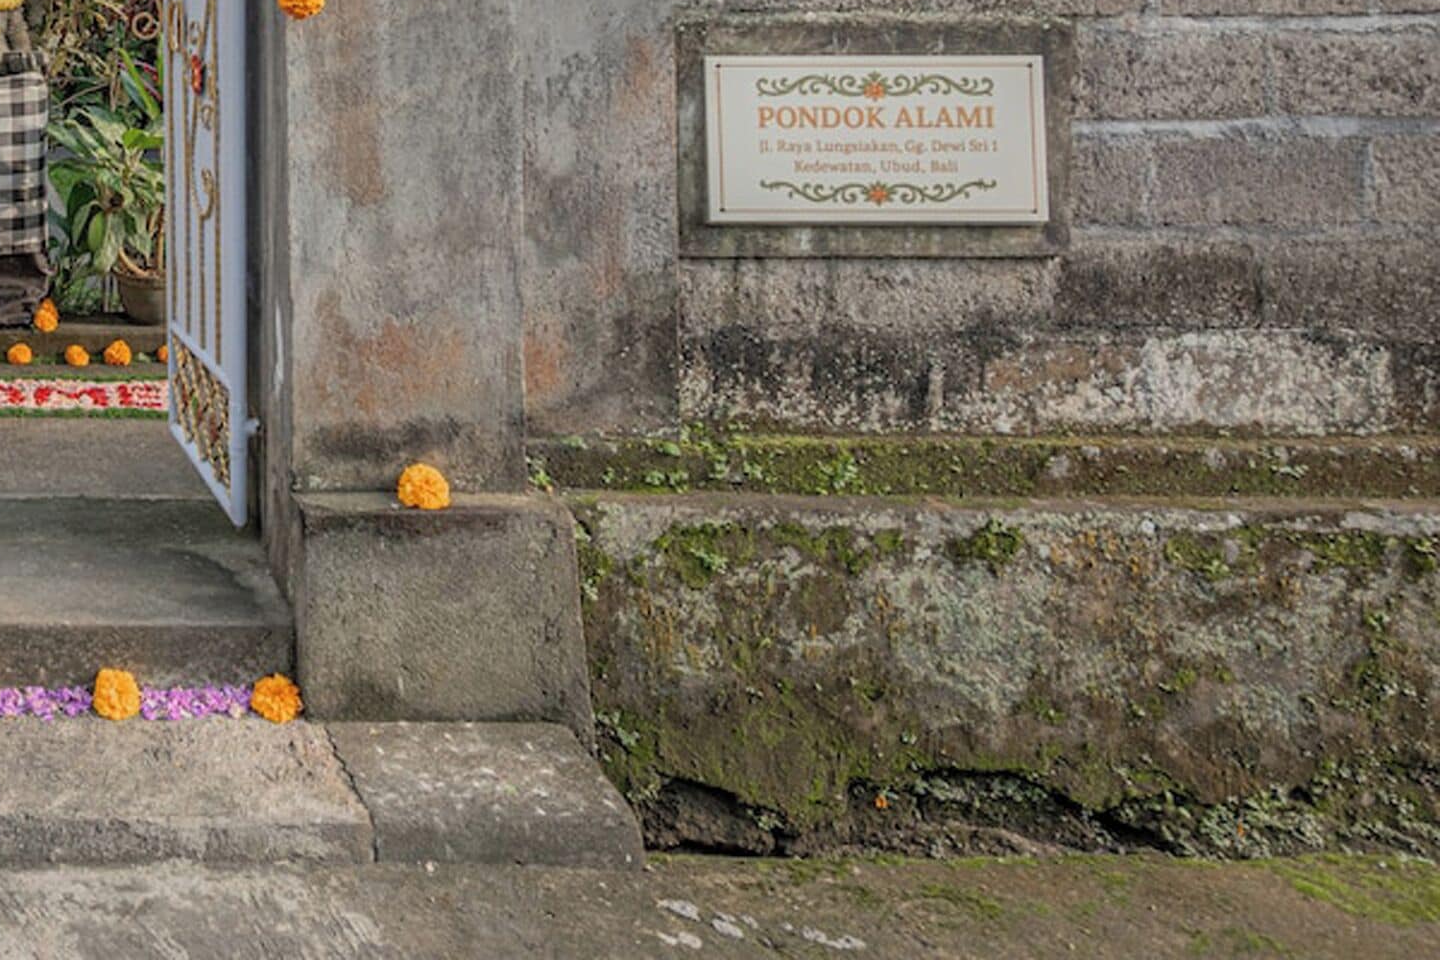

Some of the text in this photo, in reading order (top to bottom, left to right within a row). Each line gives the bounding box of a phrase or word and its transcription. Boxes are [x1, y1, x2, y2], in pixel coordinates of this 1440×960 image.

[757, 106, 996, 130] PONDOK ALAMI
[777, 139, 812, 155] Raya
[931, 139, 966, 153] Dewi
[968, 138, 989, 153] Sri
[794, 160, 877, 175] Kedewatan,
[930, 159, 959, 173] Bali
